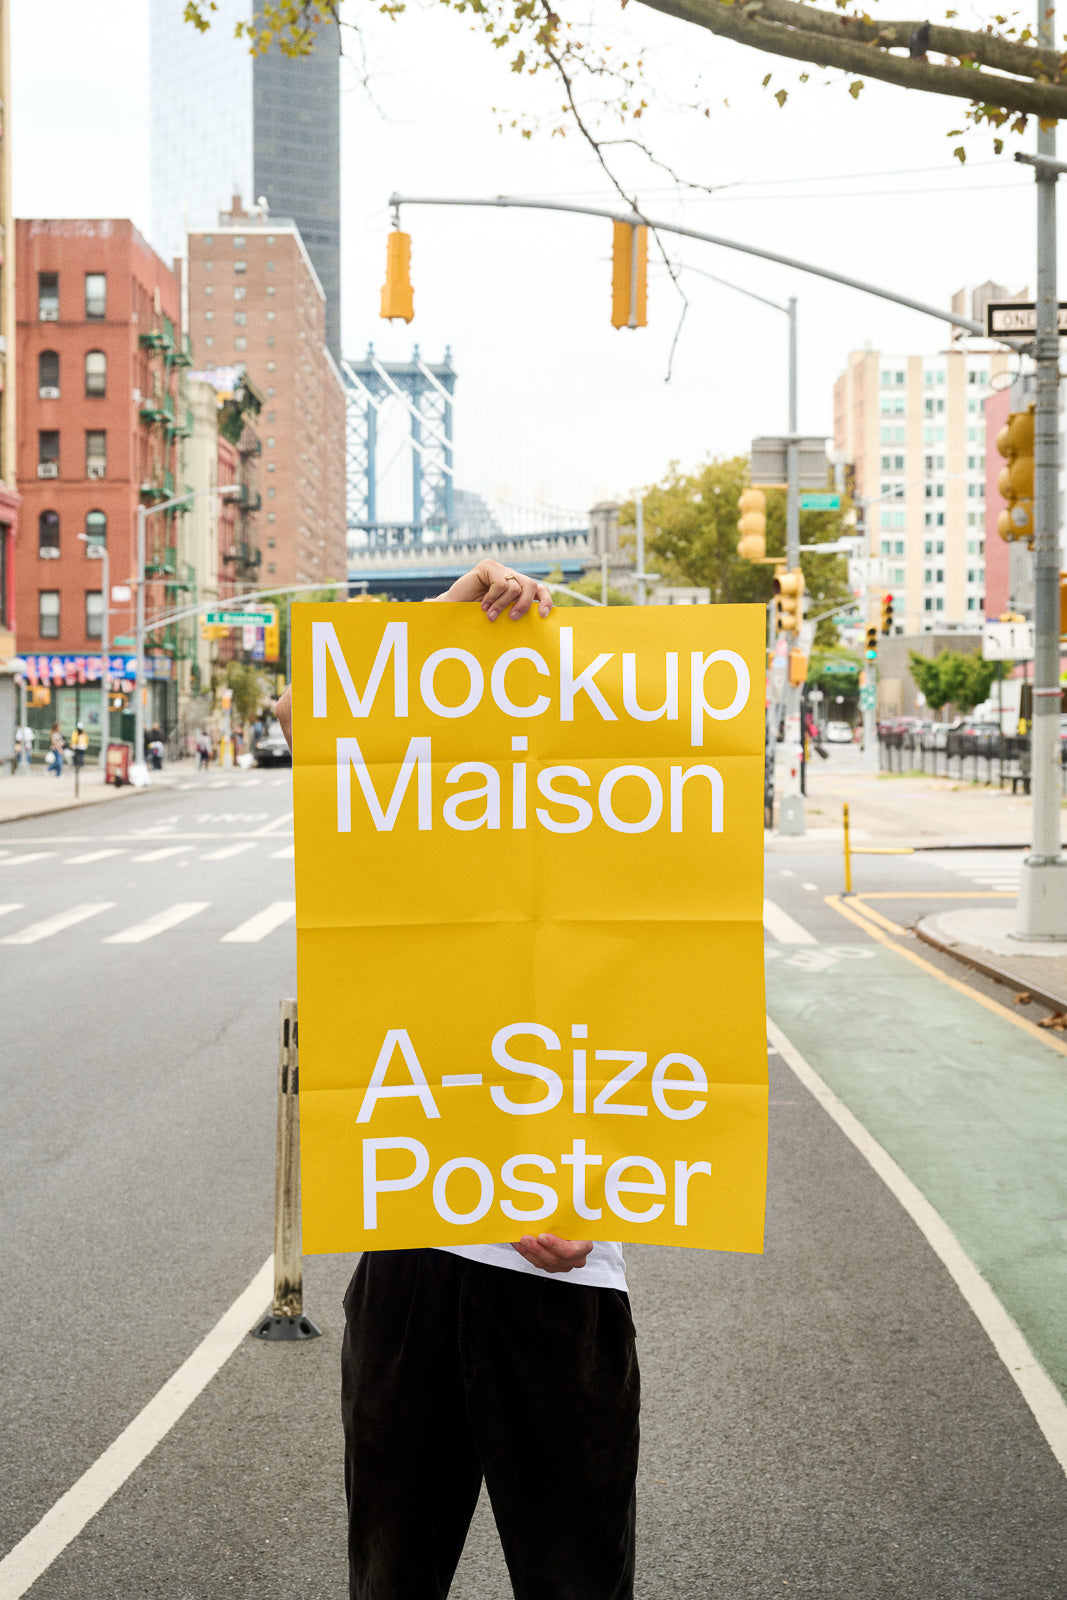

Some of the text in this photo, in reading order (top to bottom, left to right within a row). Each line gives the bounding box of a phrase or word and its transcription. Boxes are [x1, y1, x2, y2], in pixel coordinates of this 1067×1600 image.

[311, 621, 752, 747] Mockup
[336, 736, 725, 833] Maison
[355, 1022, 709, 1124] A-Size
[362, 1136, 712, 1230] Poster
